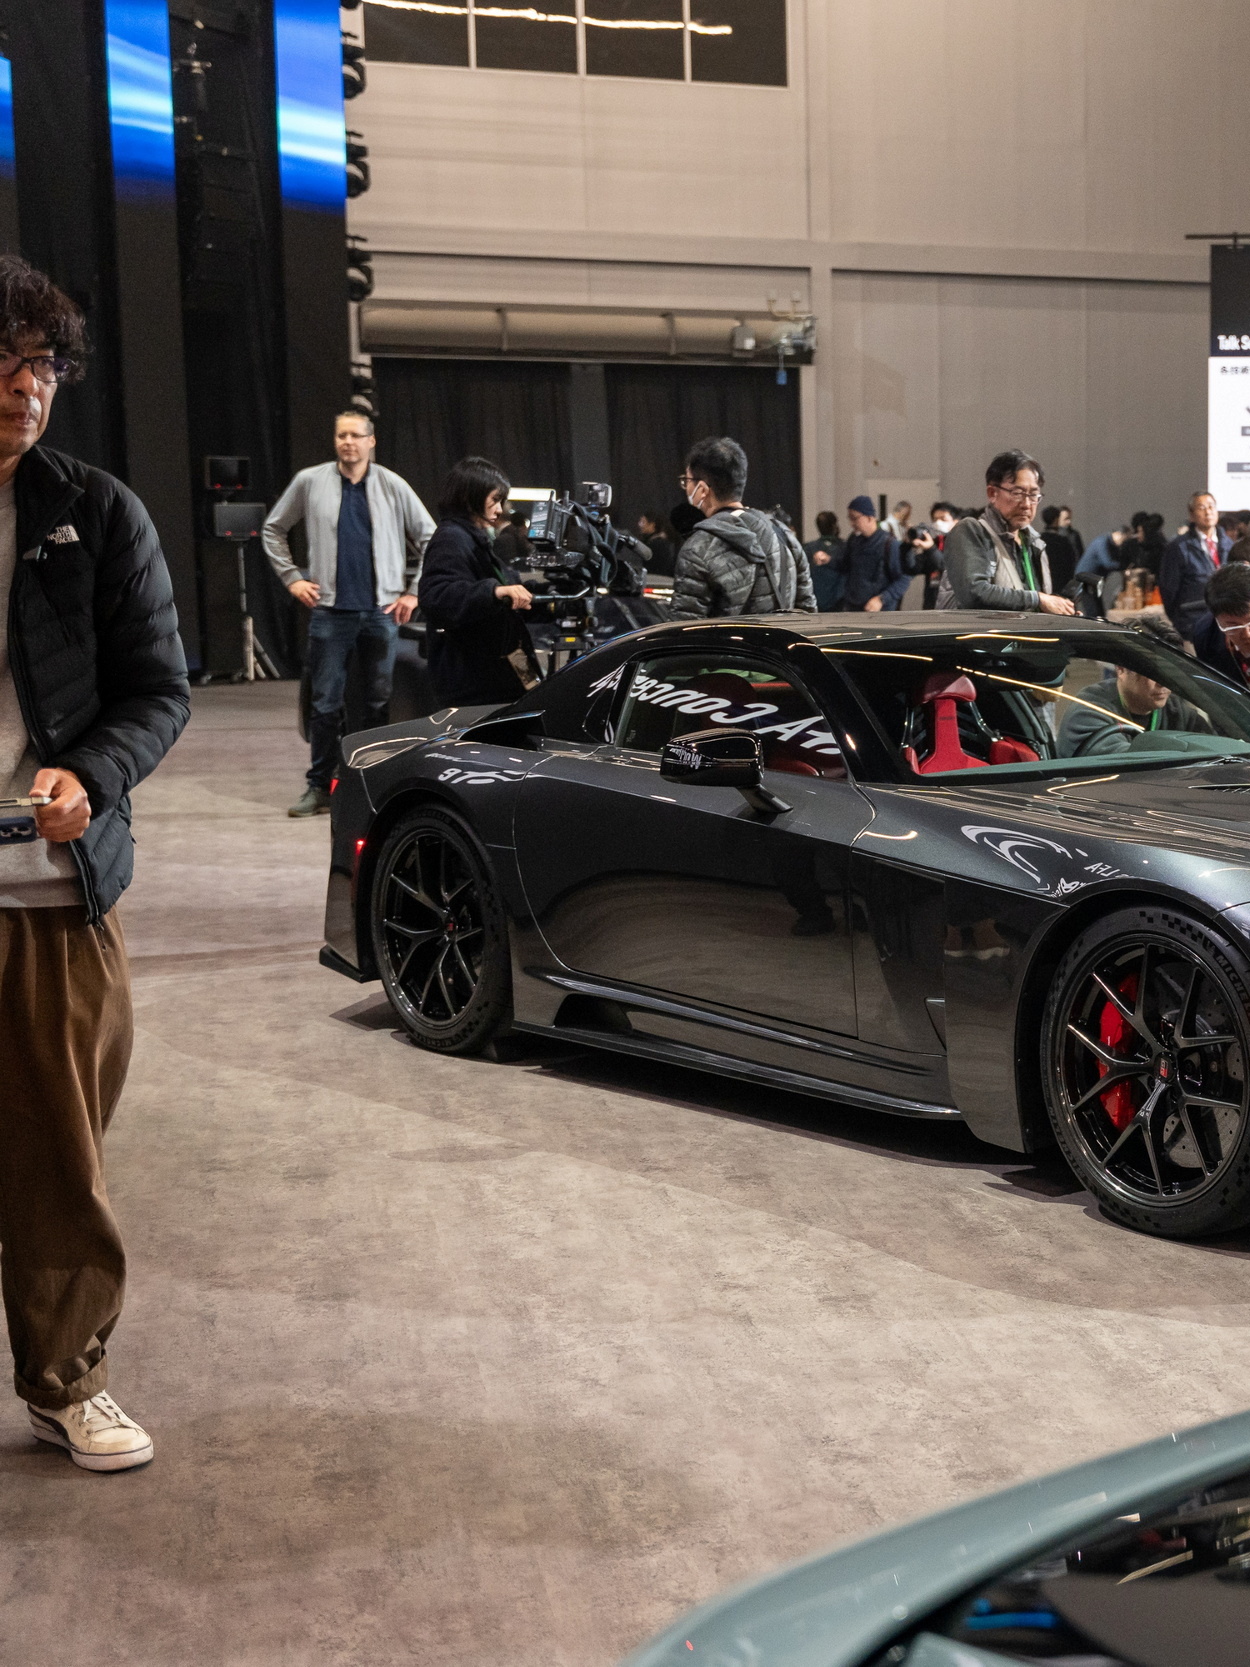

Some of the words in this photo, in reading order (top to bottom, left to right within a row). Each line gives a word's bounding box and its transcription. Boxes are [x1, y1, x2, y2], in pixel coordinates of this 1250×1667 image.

[1217, 334, 1240, 350] Talk
[56, 525, 69, 533] THE
[46, 530, 72, 540] NORTH
[55, 537, 73, 545] FACE
